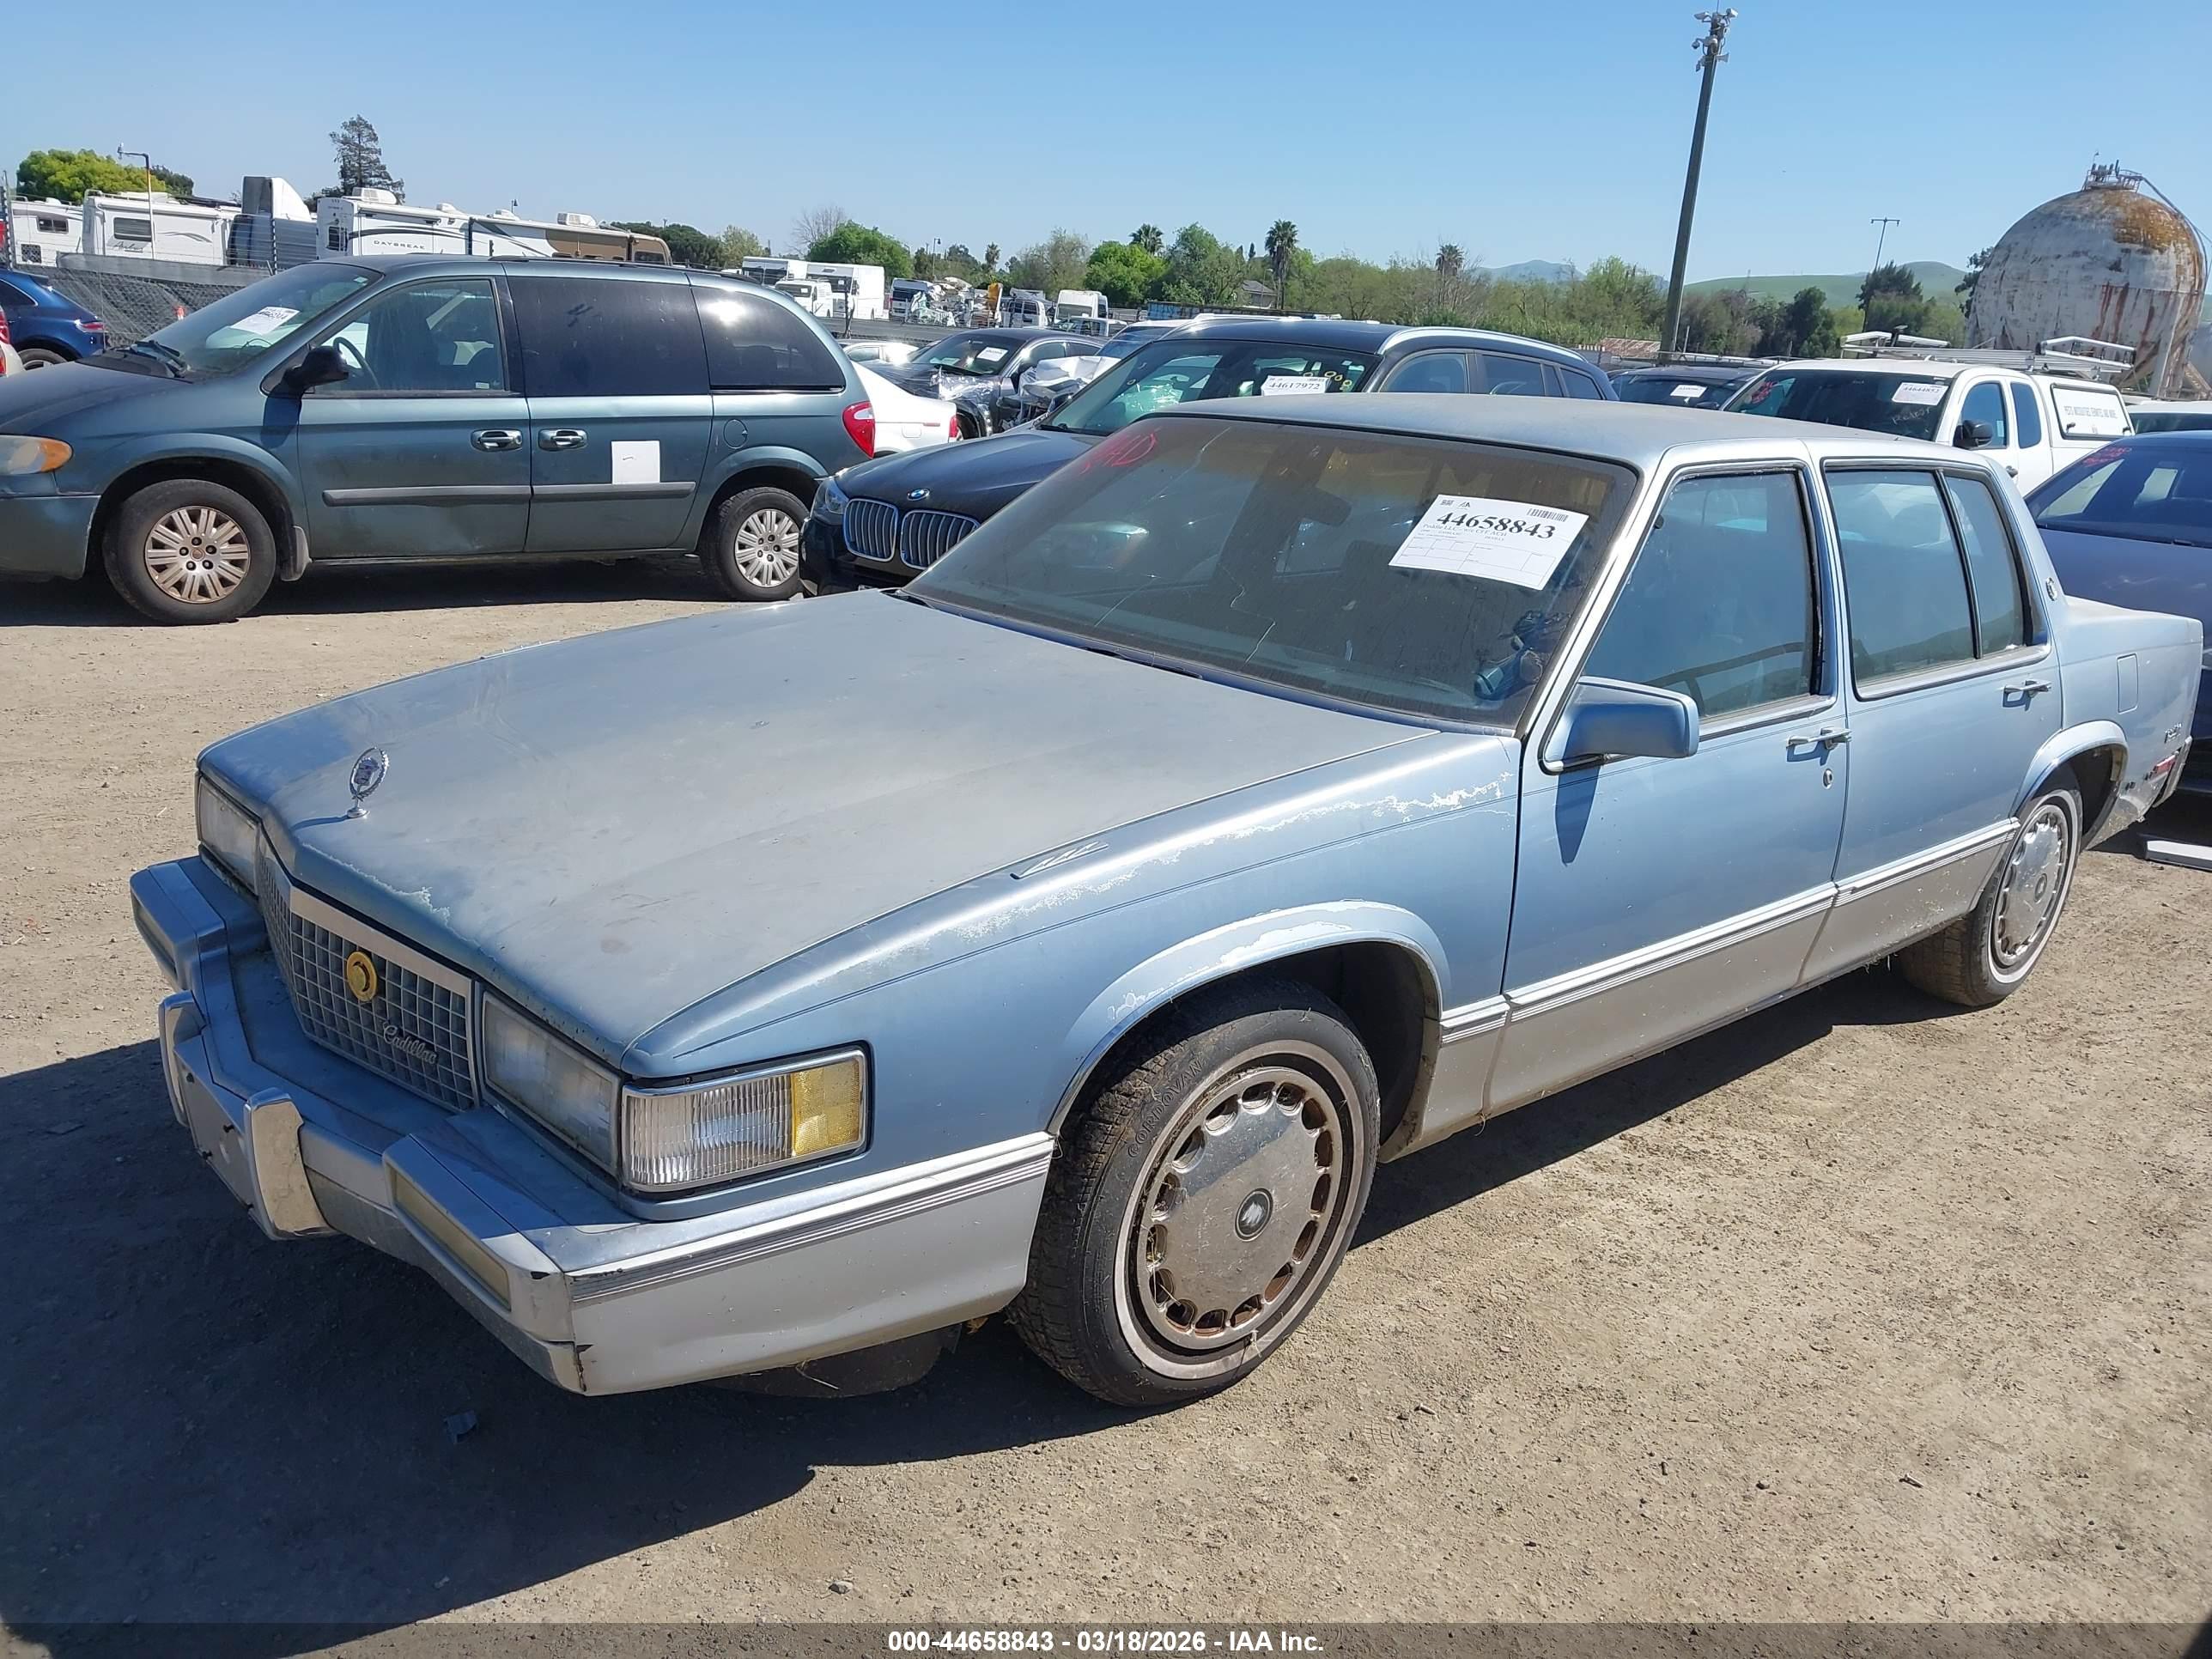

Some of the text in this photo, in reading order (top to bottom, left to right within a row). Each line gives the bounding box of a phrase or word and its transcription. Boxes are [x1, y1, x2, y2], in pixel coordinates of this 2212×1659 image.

[374, 240, 425, 250] DAYBREAK
[1437, 512, 1556, 539] 44658843
[383, 1021, 437, 1065] Cadillac
[1127, 1058, 1203, 1158] CORDOVAN
